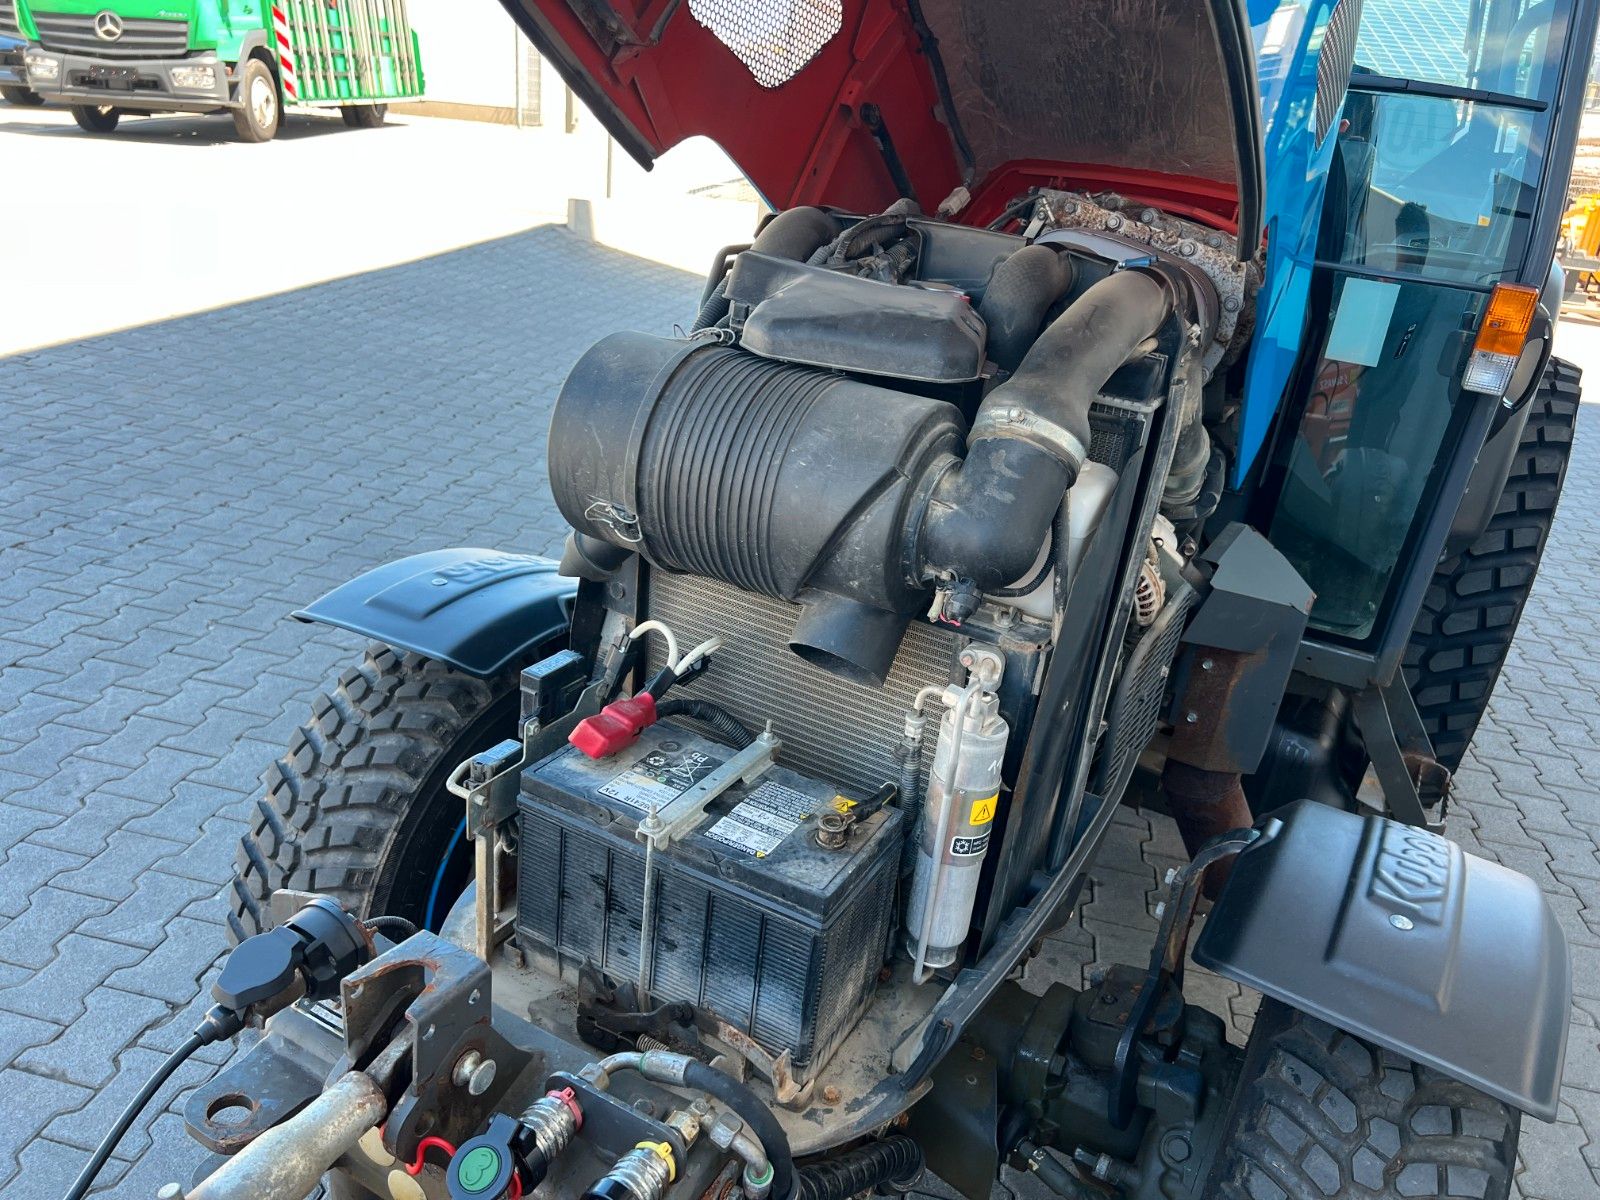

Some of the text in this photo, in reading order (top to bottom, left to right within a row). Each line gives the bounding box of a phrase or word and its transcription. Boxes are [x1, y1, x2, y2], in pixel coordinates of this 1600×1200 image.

[691, 752, 709, 763] Pb
[602, 787, 620, 798] 12V
[1373, 825, 1451, 911] Kubo
